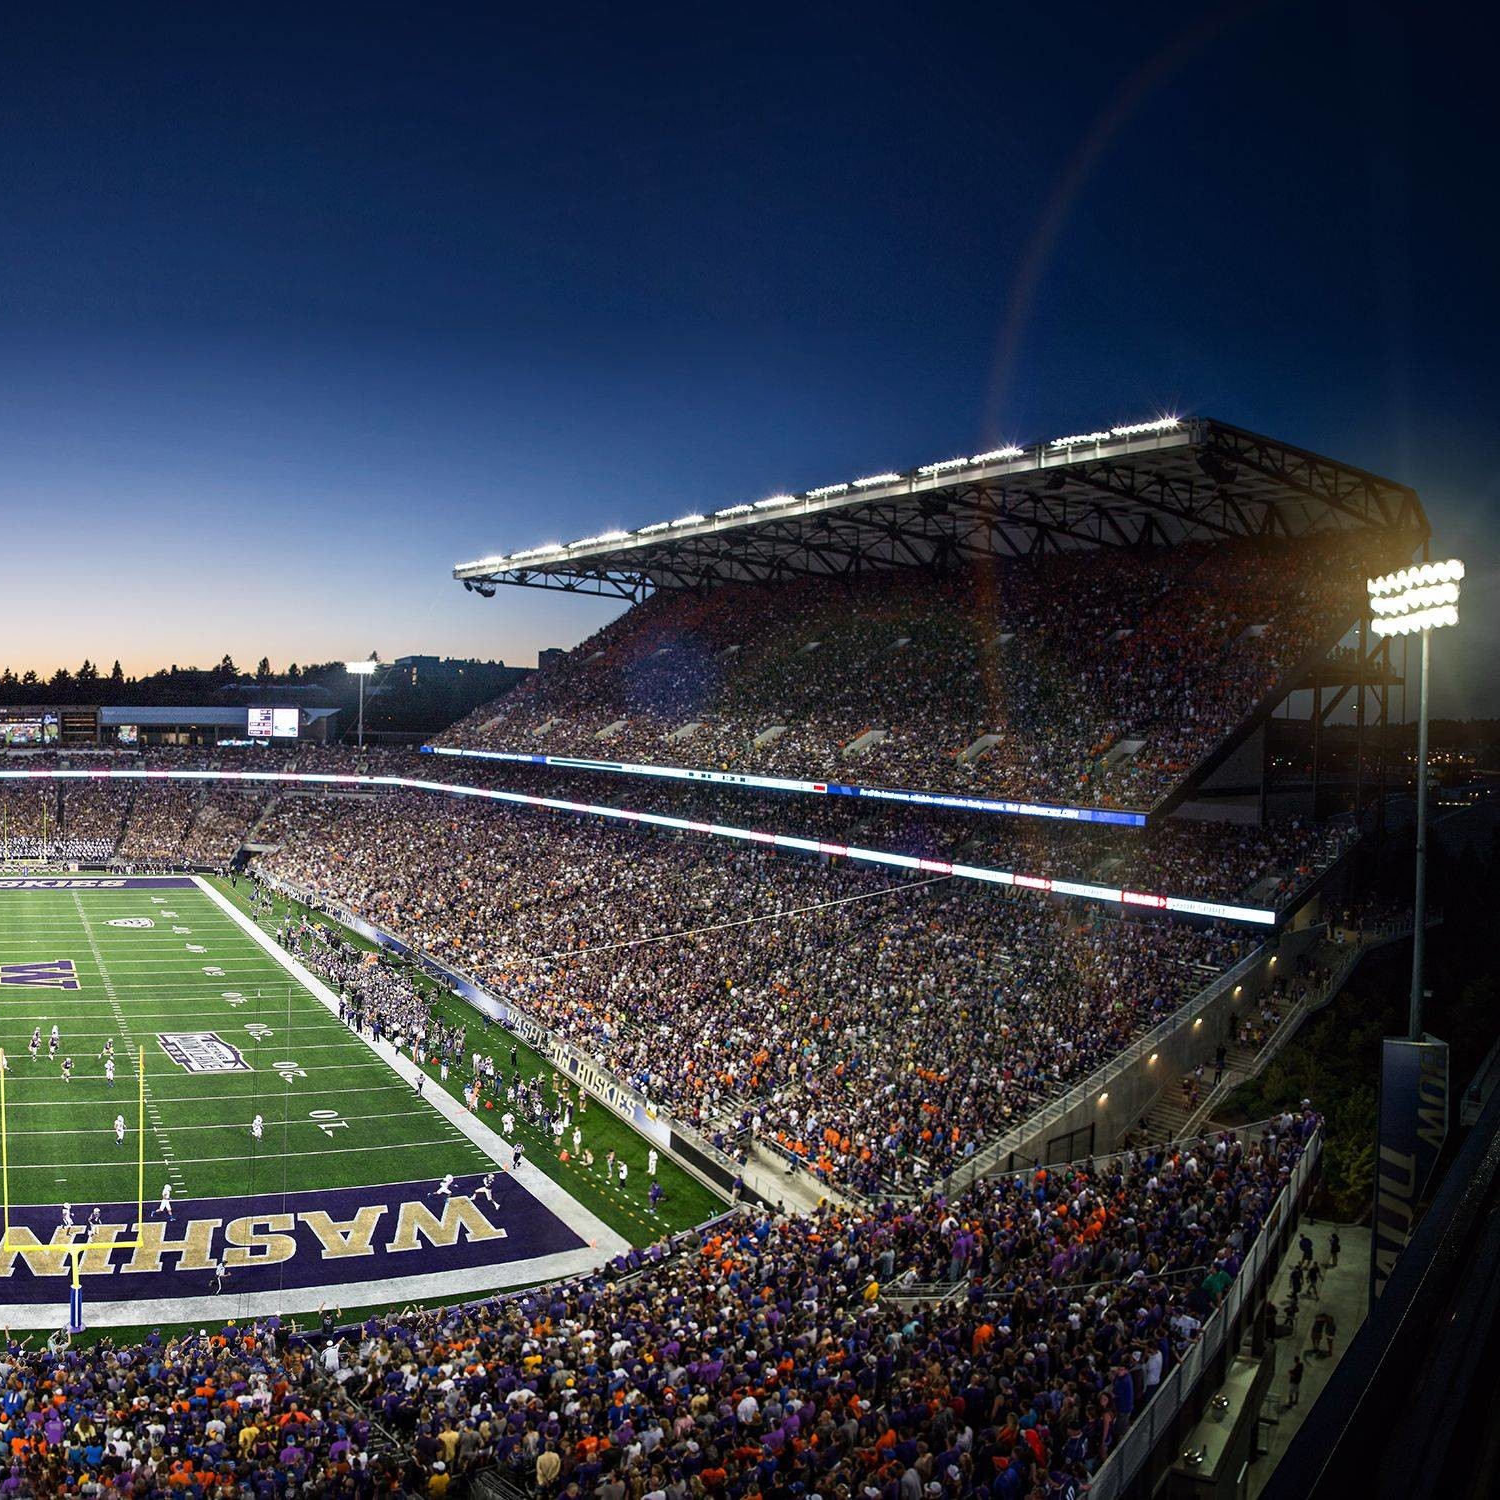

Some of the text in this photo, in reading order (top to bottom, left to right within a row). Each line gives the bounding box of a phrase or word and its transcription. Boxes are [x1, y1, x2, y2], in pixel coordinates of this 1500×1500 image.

[272, 1061, 308, 1079] 20
[577, 1062, 636, 1119] HUSKIES
[308, 1109, 350, 1130] 10
